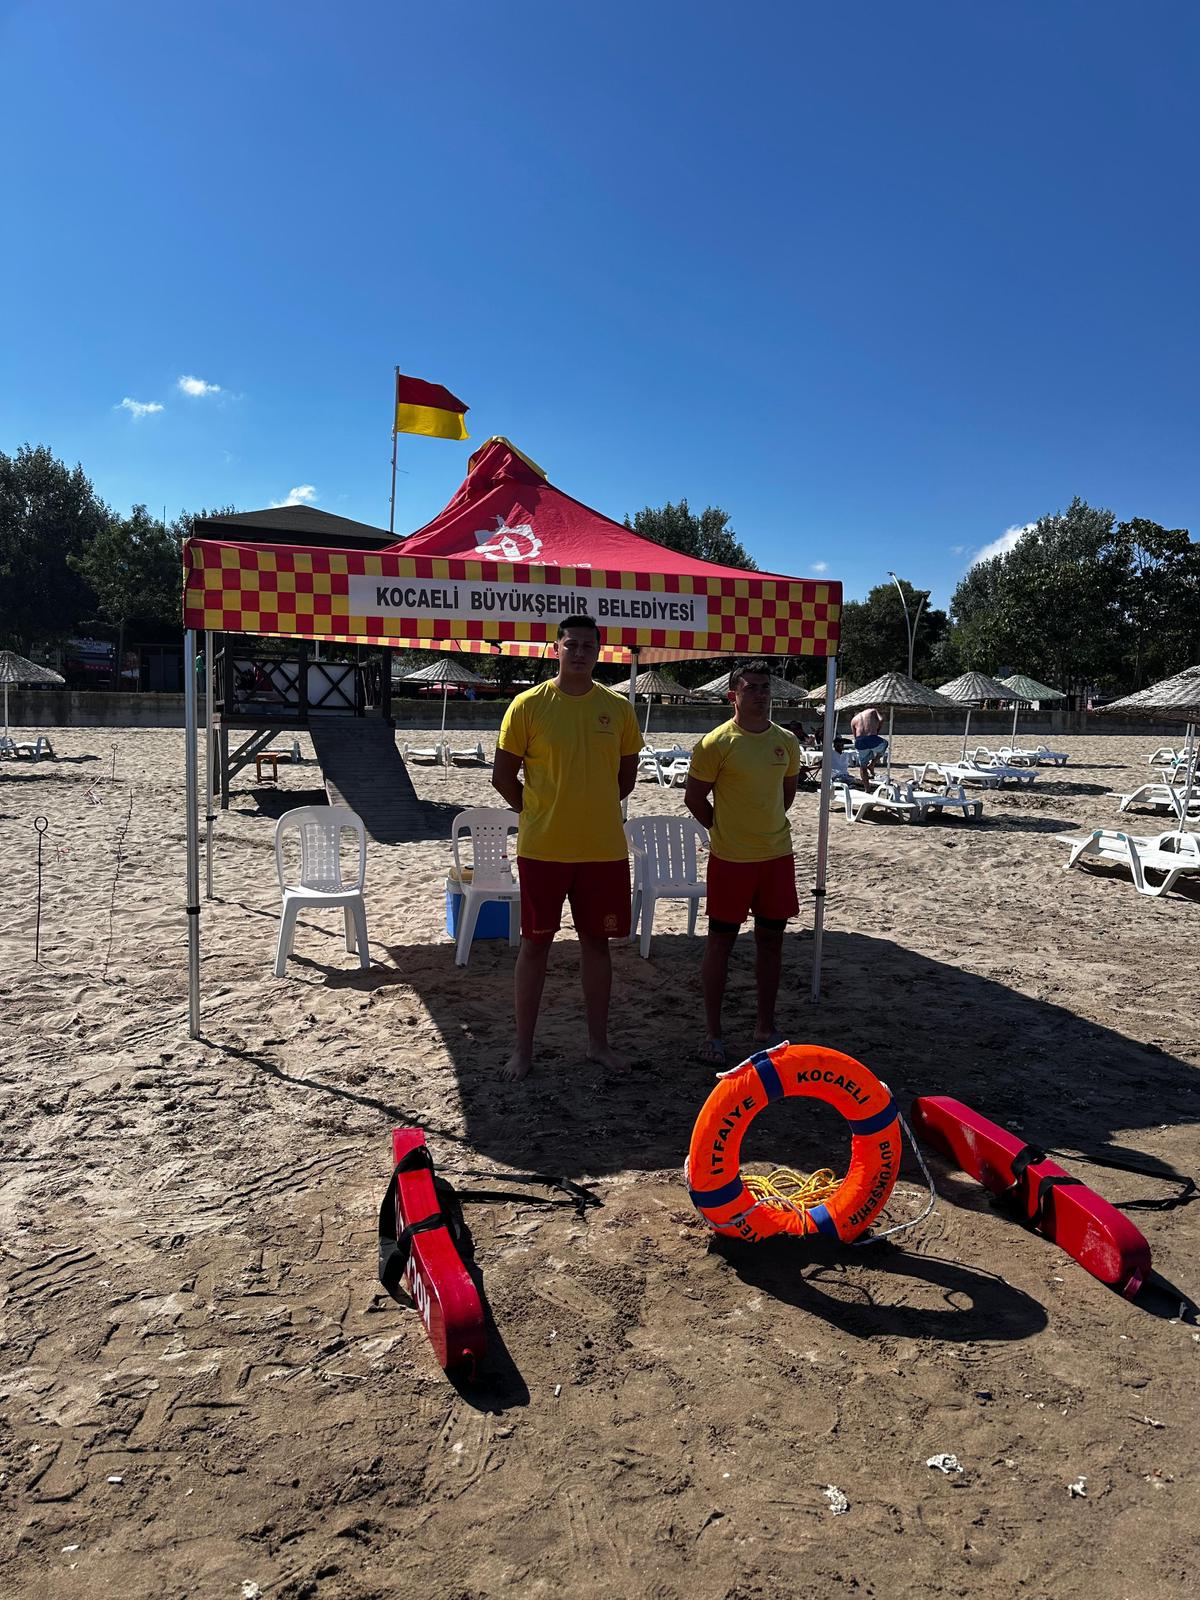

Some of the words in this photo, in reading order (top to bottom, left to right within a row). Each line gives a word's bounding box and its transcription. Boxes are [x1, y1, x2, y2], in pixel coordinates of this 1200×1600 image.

[376, 586, 459, 609] KOCAELİ
[470, 588, 588, 617] BÜYÜKŞEHİR
[598, 597, 694, 621] BELEDİYESİ
